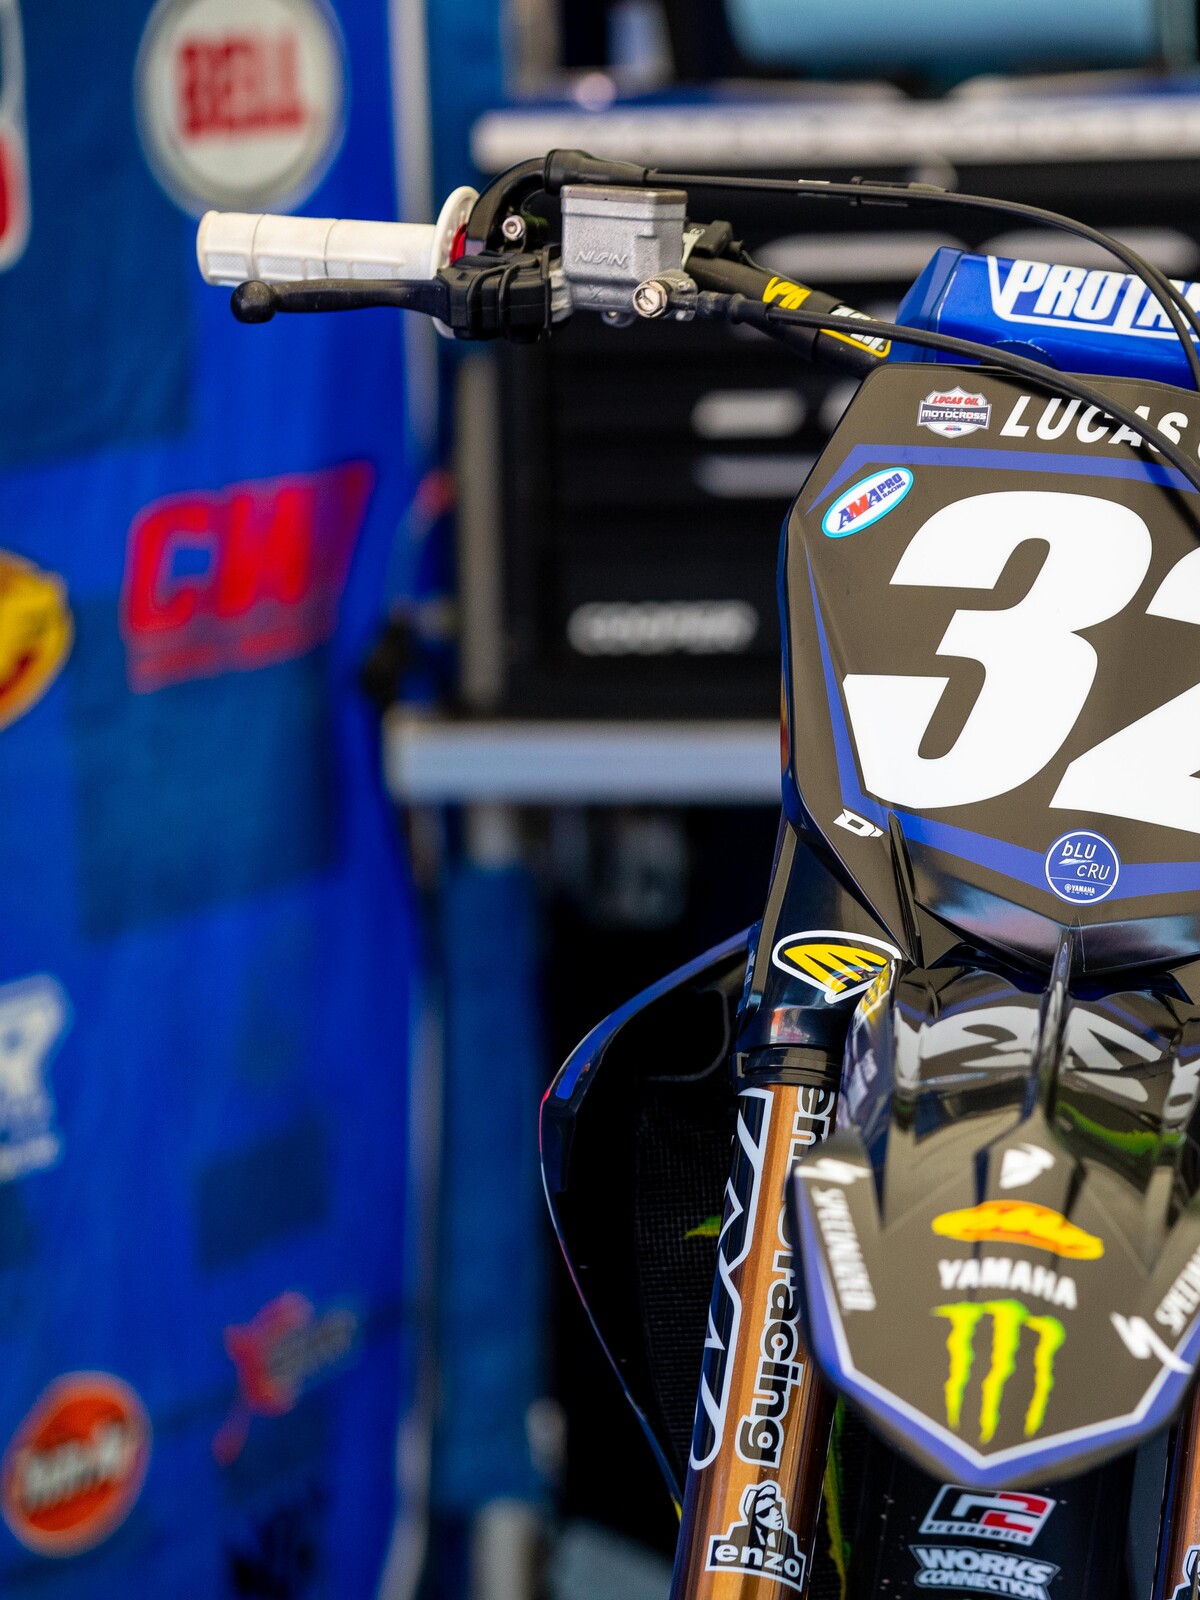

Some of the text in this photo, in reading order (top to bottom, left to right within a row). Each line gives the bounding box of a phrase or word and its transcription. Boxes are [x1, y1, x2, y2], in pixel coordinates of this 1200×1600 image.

[922, 410, 987, 419] MOTOCROSS
[932, 396, 979, 405] LUCAS OIL
[1000, 396, 1188, 452] LUCAS
[876, 473, 903, 494] PRO
[882, 480, 906, 498] RACING
[837, 488, 883, 531] AMA
[938, 1257, 1078, 1310] YAMAHA
[714, 1544, 801, 1578] enzo
[915, 1548, 1053, 1584] WORKS
[917, 1569, 1047, 1600] CONNECTION
